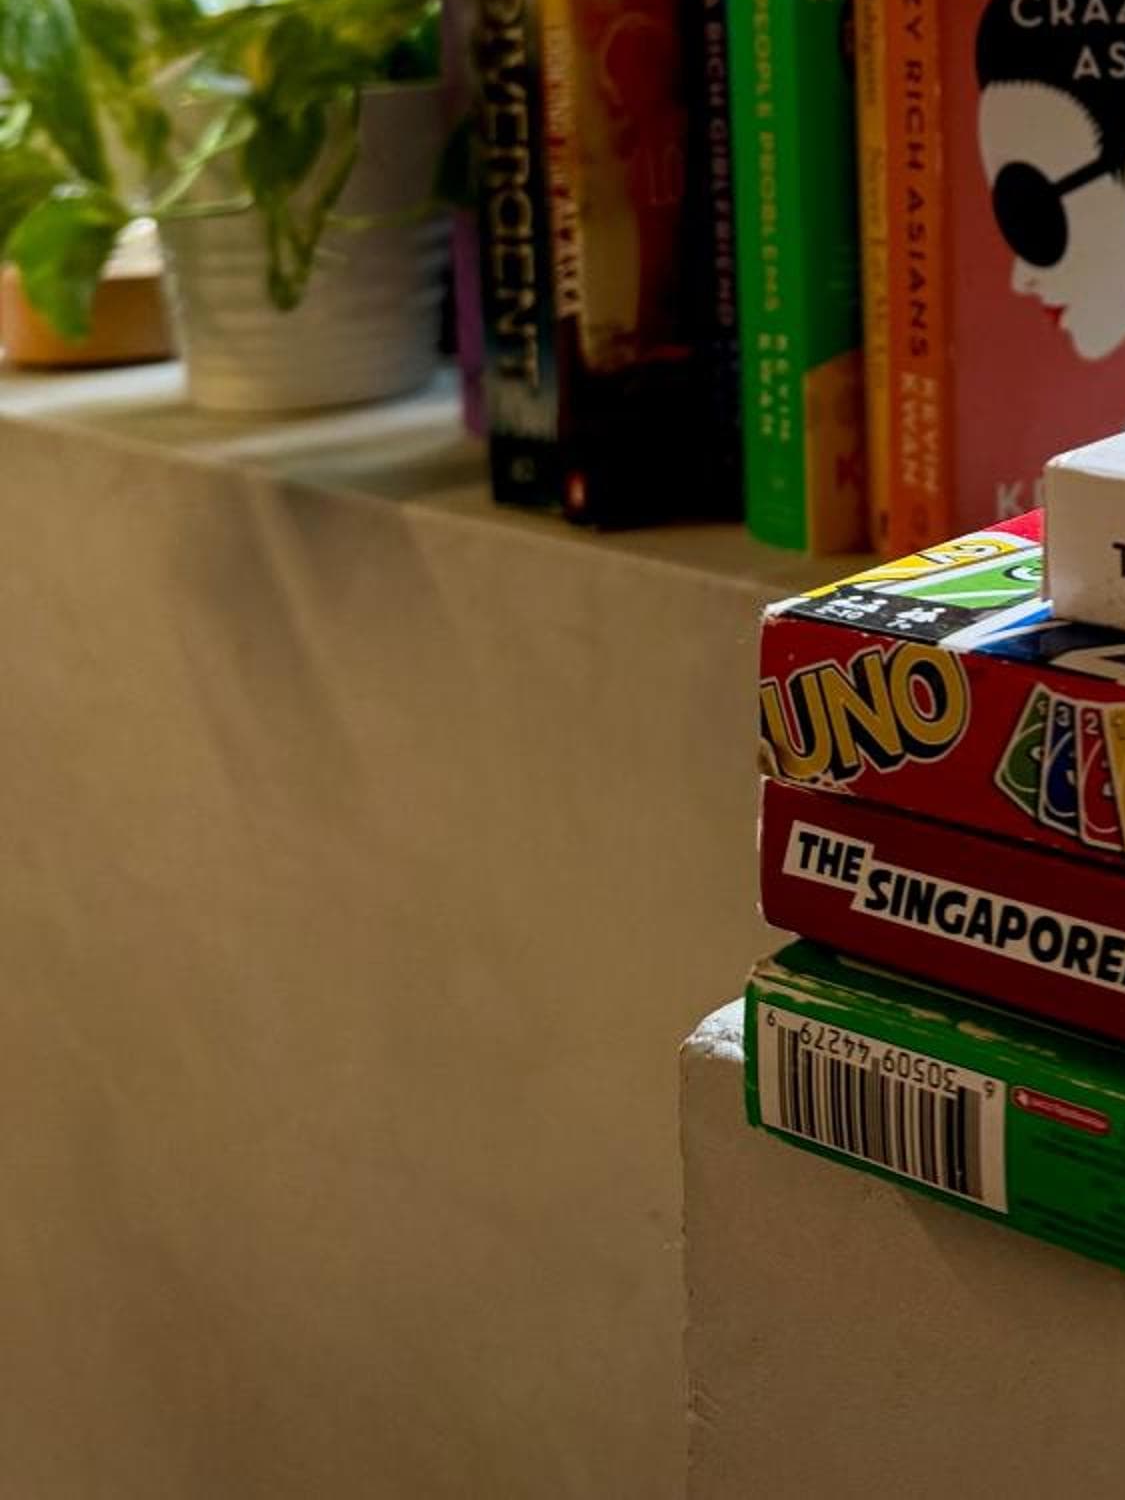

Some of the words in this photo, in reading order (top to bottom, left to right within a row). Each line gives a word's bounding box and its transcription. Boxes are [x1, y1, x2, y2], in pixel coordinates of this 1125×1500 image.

[703, 19, 728, 109] RICH
[906, 59, 927, 172] RICH
[708, 115, 736, 327] GIRLFRIEND
[756, 131, 782, 314] PROBLEMS
[907, 188, 930, 359] ASIANS
[899, 371, 920, 486] KWAN
[760, 640, 971, 783] UNO
[797, 830, 866, 885] THE
[766, 1010, 778, 1027] 9
[800, 1023, 871, 1064] 44279
[882, 1049, 960, 1094] 30509
